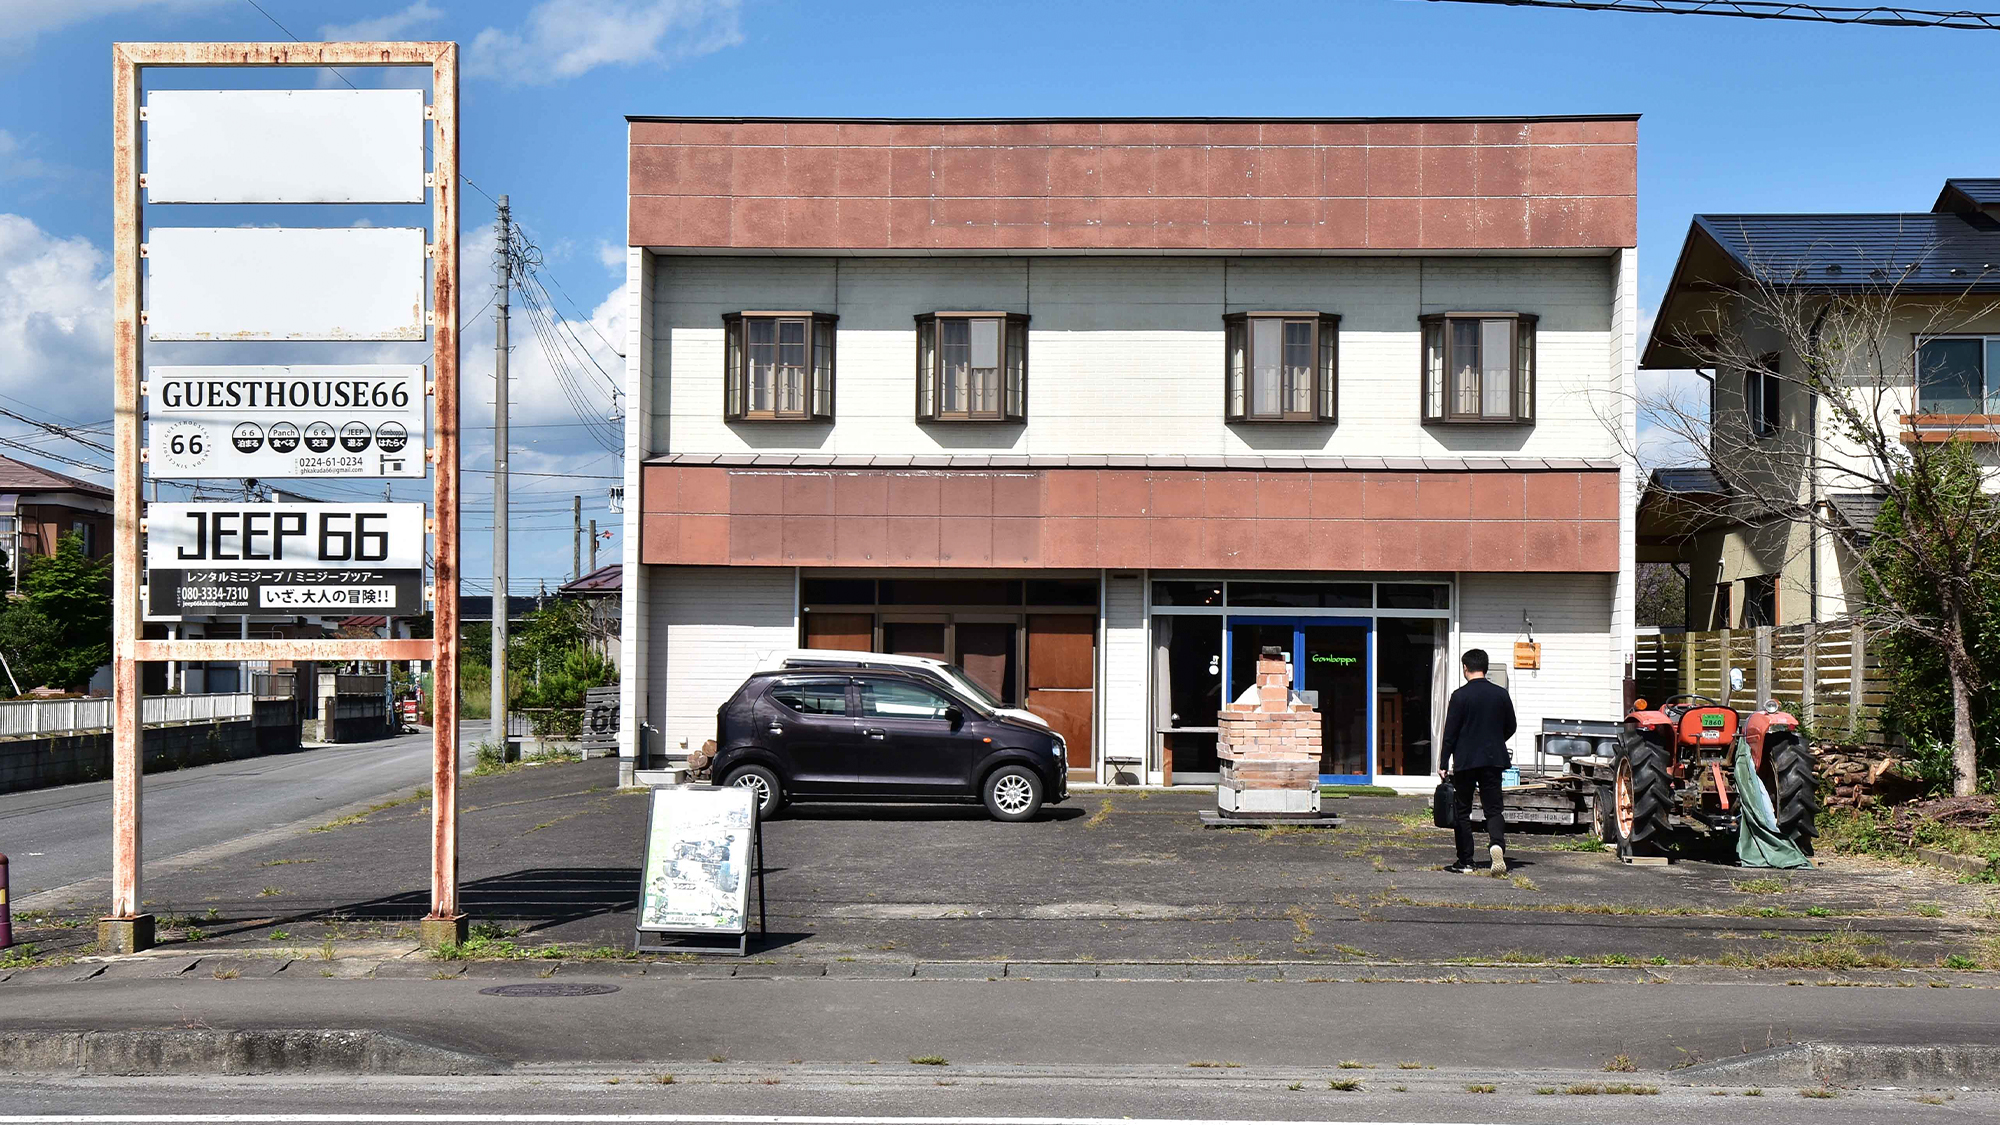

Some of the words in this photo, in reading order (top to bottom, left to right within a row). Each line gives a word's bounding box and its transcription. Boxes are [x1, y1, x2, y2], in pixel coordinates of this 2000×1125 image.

[162, 381, 409, 408] GUESTHOUSE66
[273, 429, 295, 437] Panch
[171, 434, 203, 455] 66
[237, 439, 259, 448] 泊まる
[273, 439, 296, 448] 食べる
[311, 439, 329, 447] 交流
[347, 439, 364, 447] 遊ぶ
[378, 439, 405, 447] はたらく
[299, 456, 363, 467] 0224-61-0234
[177, 512, 307, 560] JEEP
[318, 512, 388, 561] 66
[187, 571, 285, 582] レンタルミニジープ
[295, 571, 383, 582] ミニジープツアー
[181, 586, 249, 600] 080-3334-7310
[266, 588, 389, 604] いざ、大人の冒険!!
